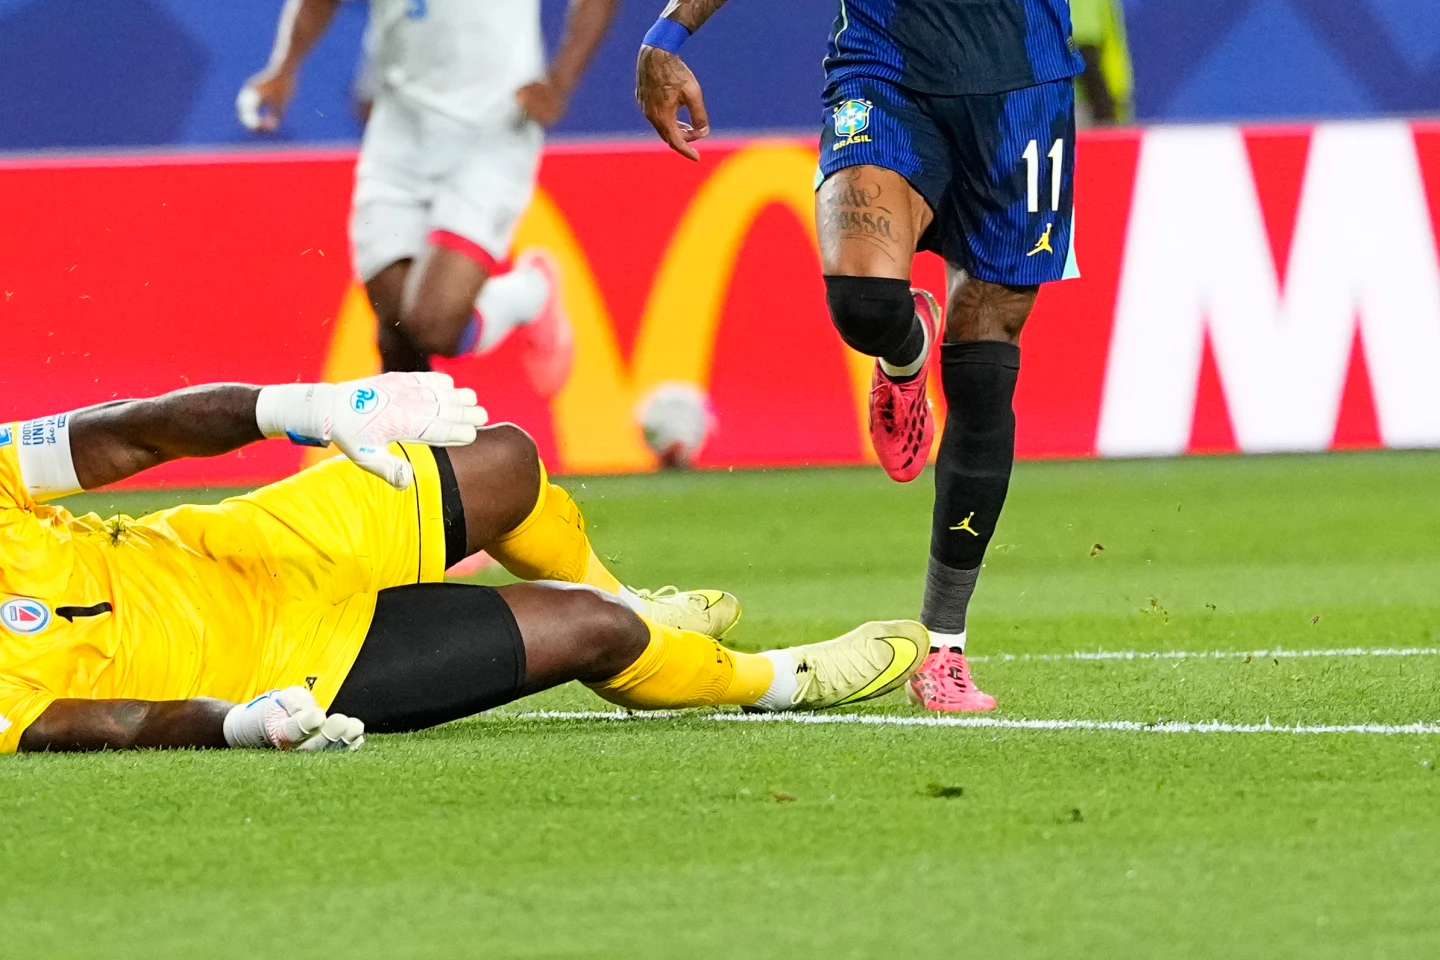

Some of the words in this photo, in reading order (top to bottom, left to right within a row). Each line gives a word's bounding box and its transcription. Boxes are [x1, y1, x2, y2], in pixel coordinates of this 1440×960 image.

[832, 134, 872, 152] BRASIL
[1021, 138, 1064, 213] 11
[1096, 121, 1440, 457] M
[32, 419, 45, 446] UNIT
[55, 601, 113, 623] 1
